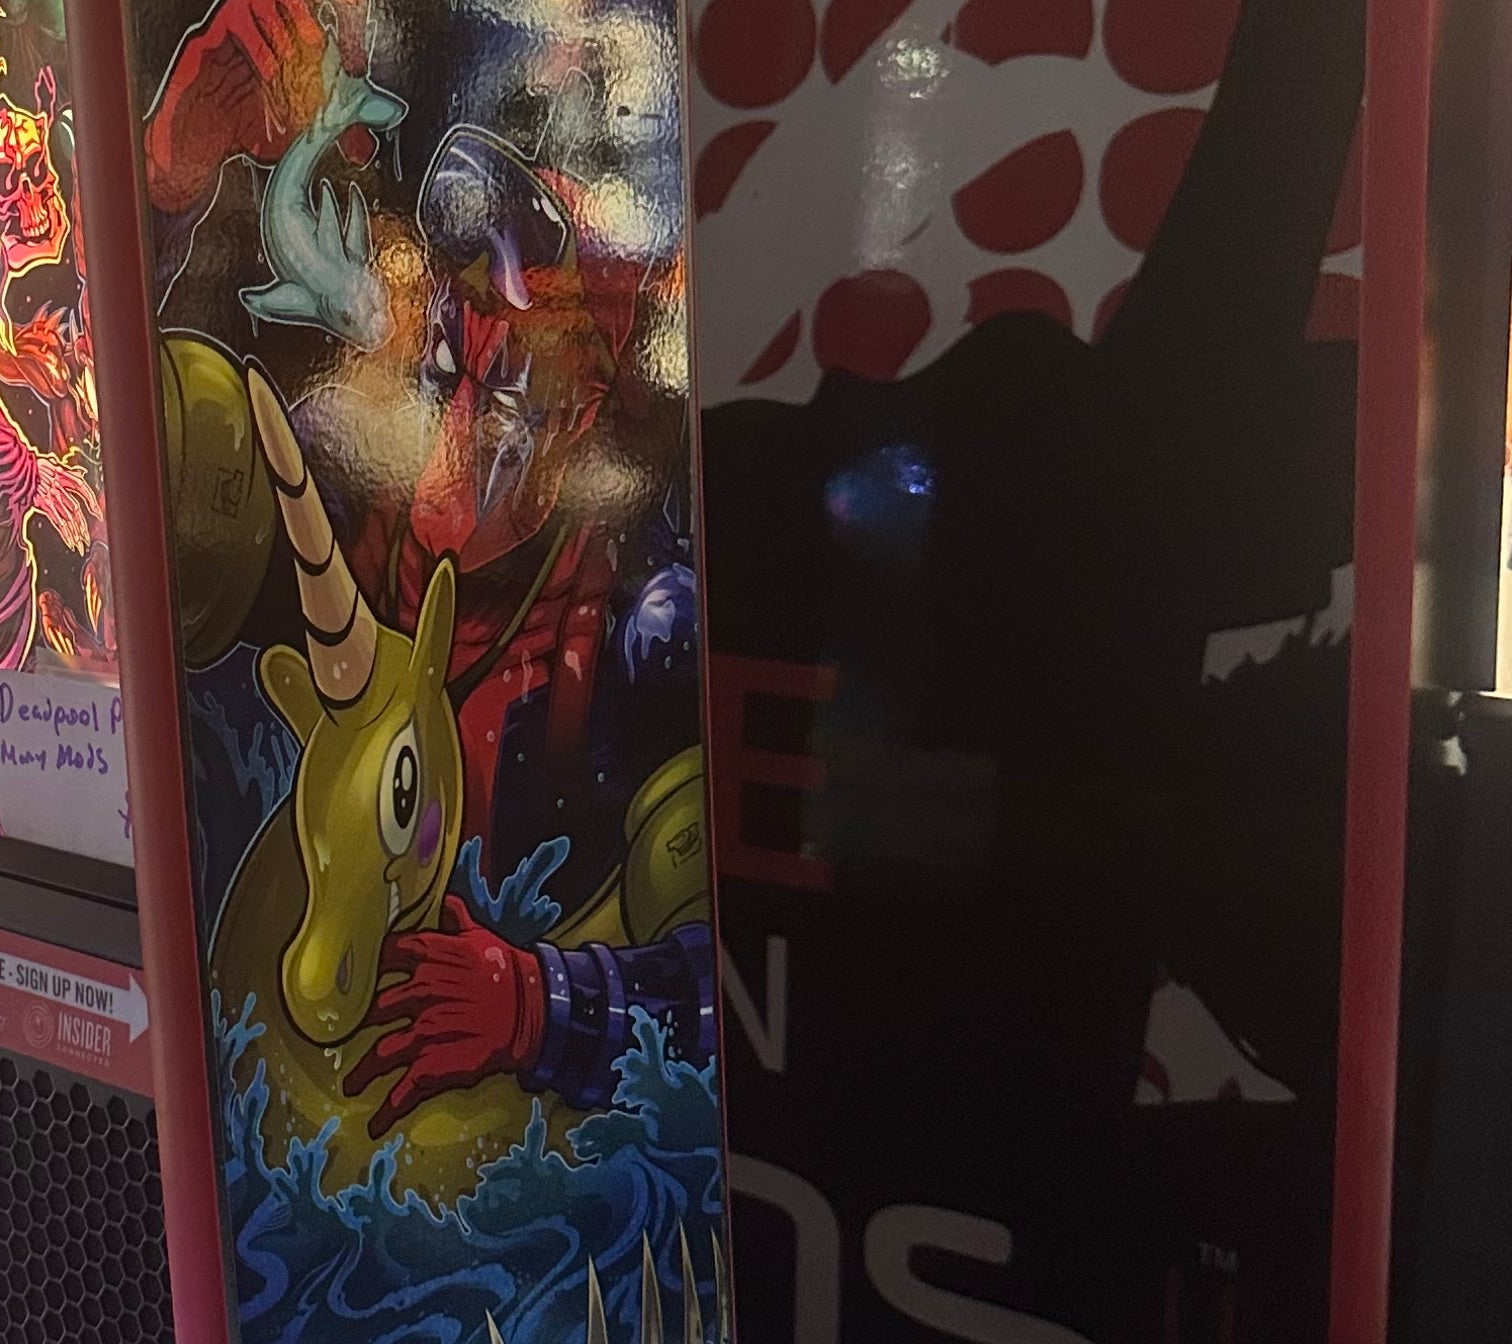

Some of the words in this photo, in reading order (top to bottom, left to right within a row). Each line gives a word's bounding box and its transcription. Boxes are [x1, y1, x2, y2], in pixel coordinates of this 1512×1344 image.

[0, 739, 47, 771] Many
[55, 742, 109, 775] Mods
[15, 963, 49, 994] SIGN
[52, 975, 72, 1001] UP
[75, 983, 115, 1015] NOW!
[57, 1011, 112, 1058] INSIDER
